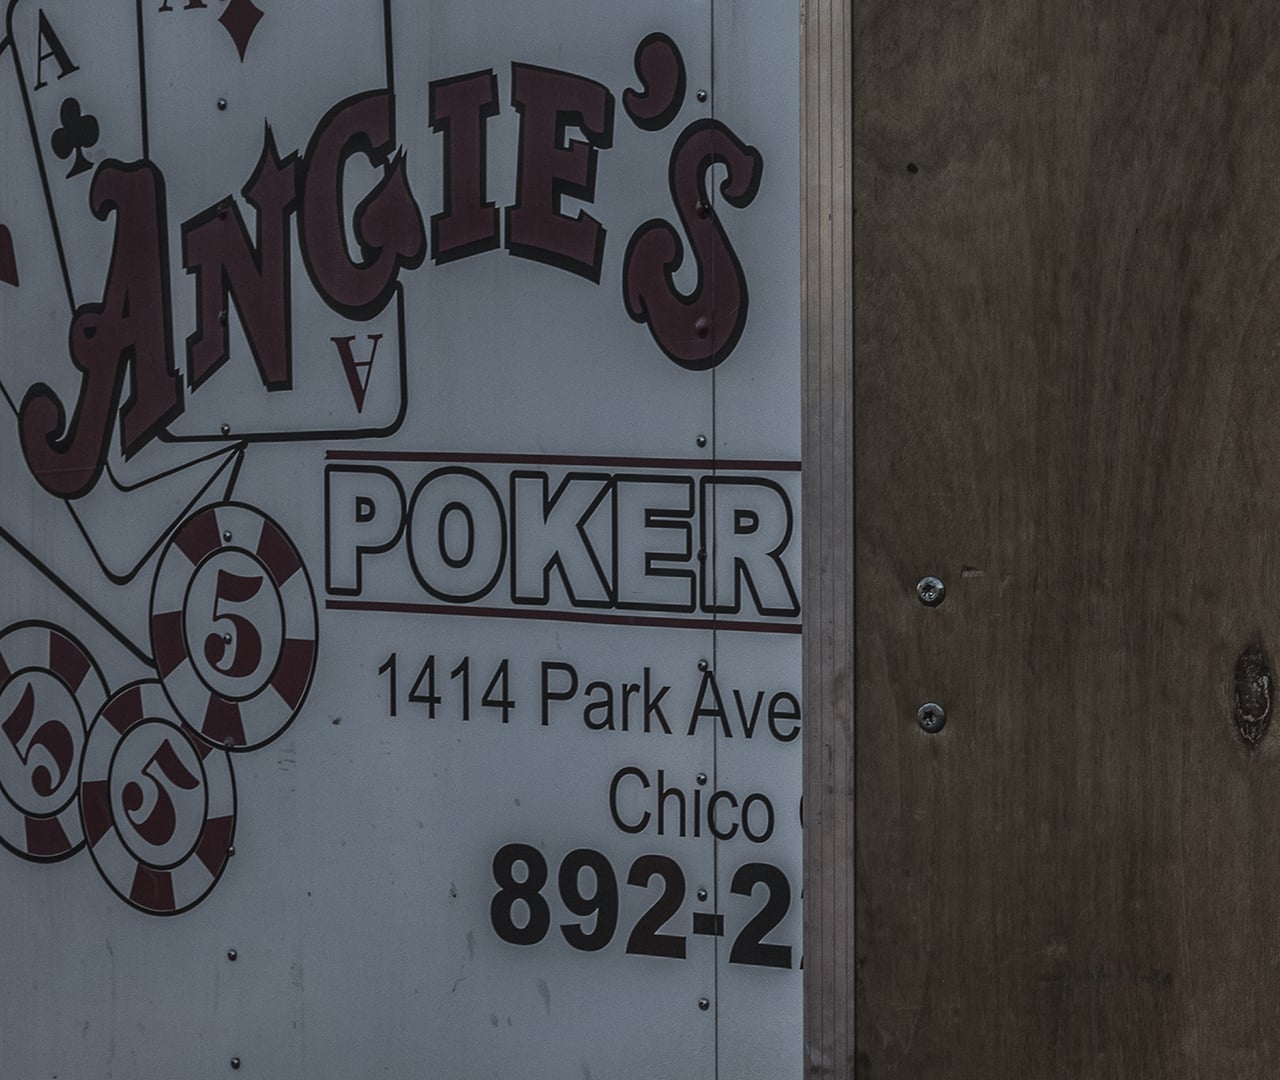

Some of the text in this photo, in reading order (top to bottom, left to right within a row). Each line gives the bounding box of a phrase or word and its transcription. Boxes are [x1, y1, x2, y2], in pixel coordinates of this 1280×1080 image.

[34, 8, 79, 91] A
[18, 32, 763, 498] ANGIE'S
[330, 333, 383, 412] A
[325, 464, 800, 616] POKER
[205, 570, 264, 677] 5
[3, 683, 74, 796] 5
[378, 653, 801, 743] 1414 Park Ave
[121, 739, 200, 846] 5
[608, 767, 775, 844] Chico
[490, 843, 803, 970] 892-2
